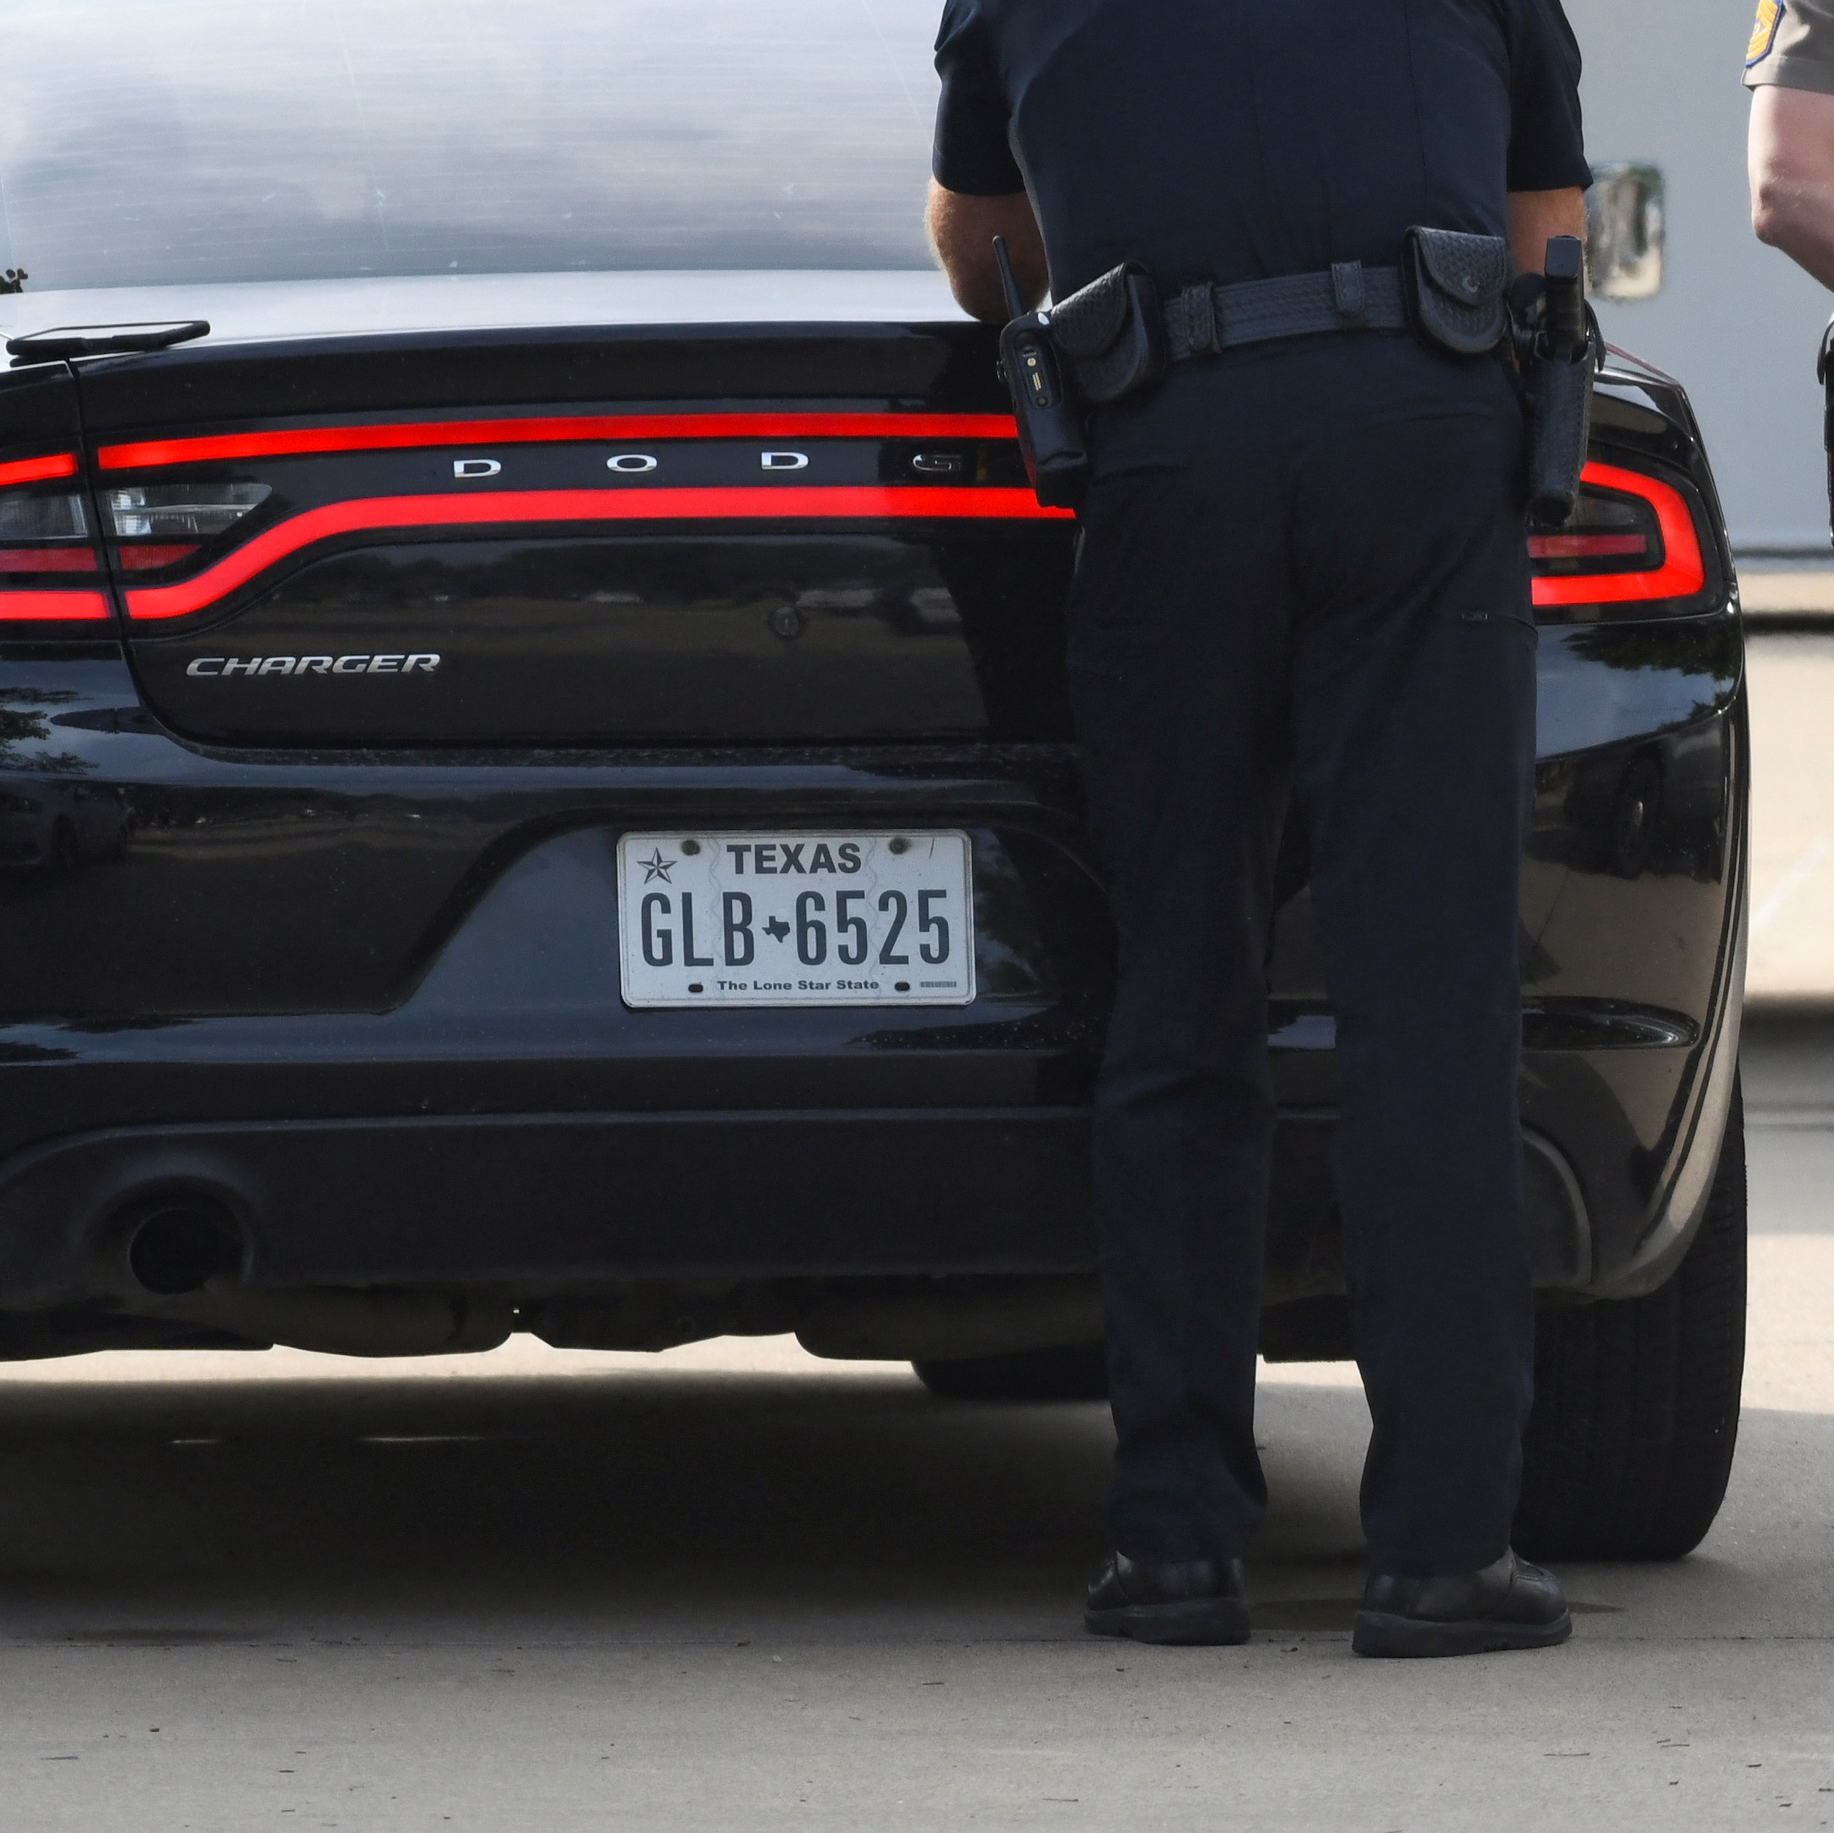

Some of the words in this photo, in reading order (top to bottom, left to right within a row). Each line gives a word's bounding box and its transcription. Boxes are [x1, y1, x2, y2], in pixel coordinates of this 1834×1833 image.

[453, 451, 962, 478] DODG
[185, 653, 441, 676] CHARGER
[726, 842, 862, 875] TEXAS
[717, 980, 748, 991] The
[753, 980, 793, 991] Lone
[797, 979, 832, 990] Star
[836, 979, 880, 990] State
